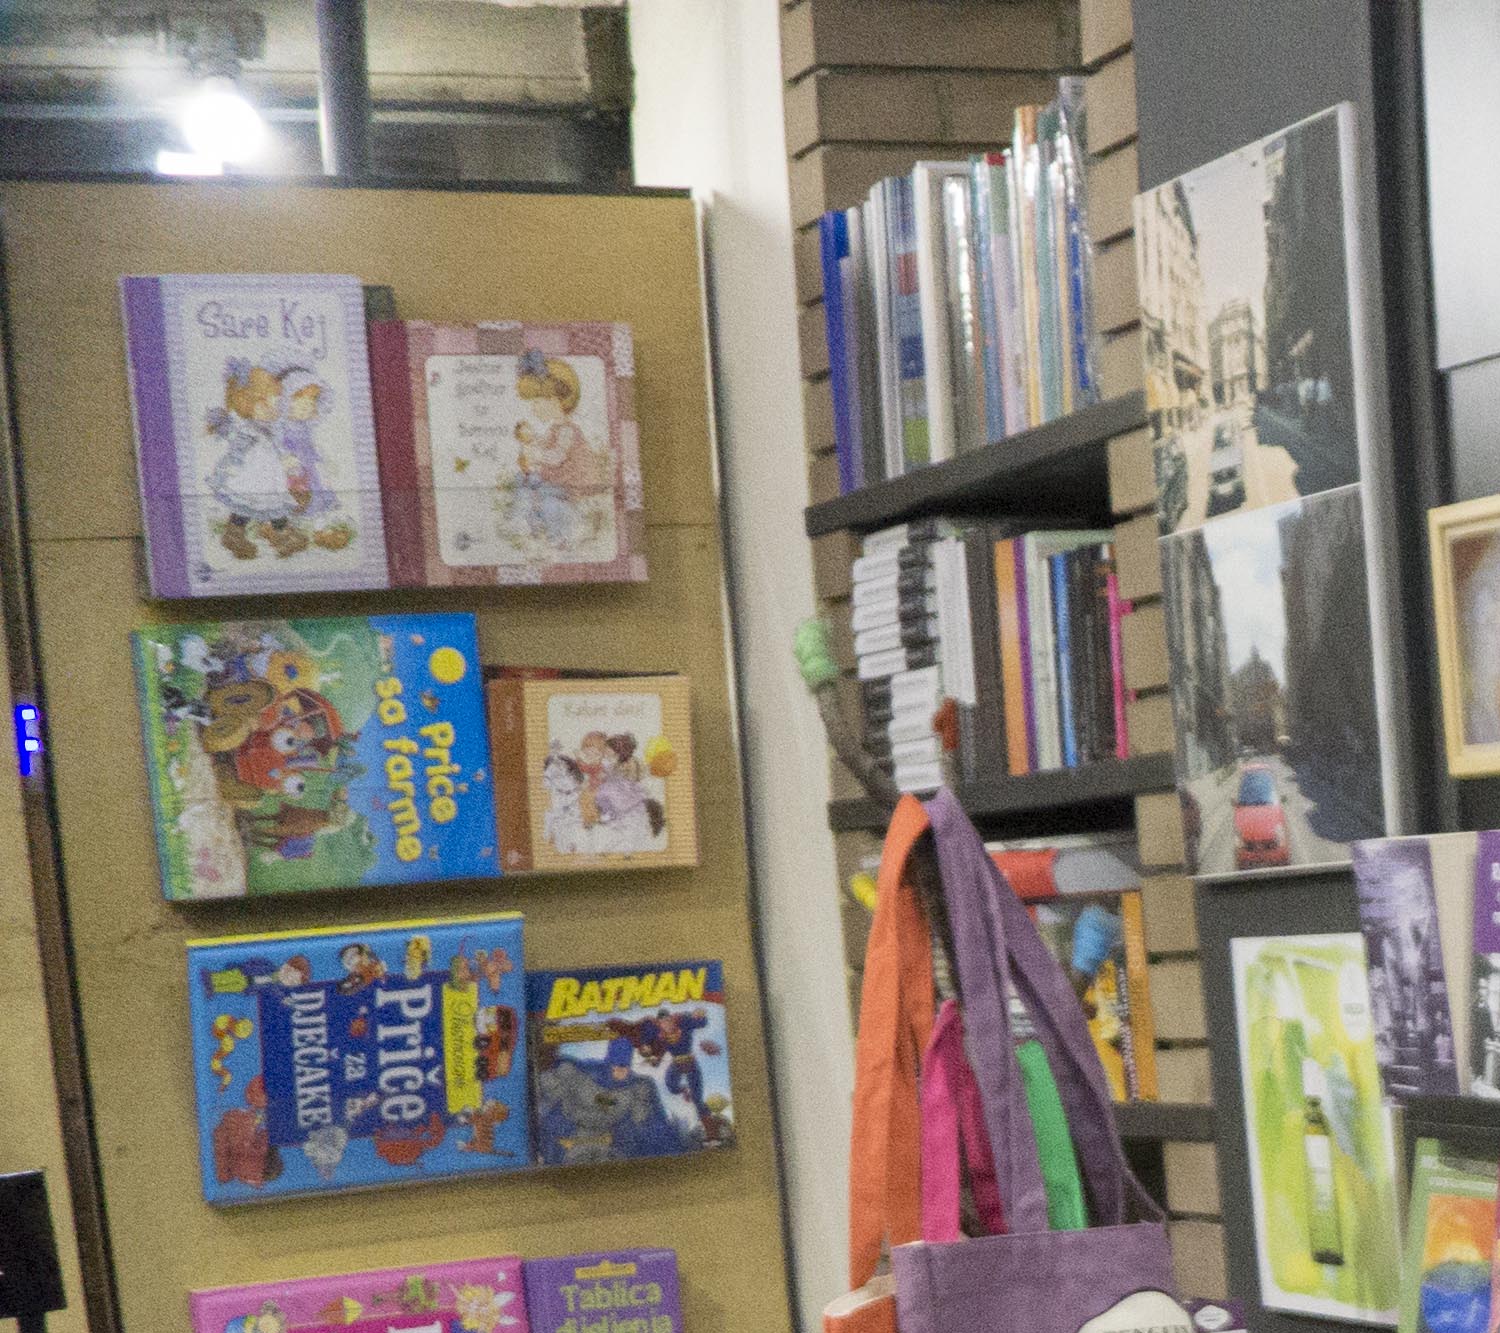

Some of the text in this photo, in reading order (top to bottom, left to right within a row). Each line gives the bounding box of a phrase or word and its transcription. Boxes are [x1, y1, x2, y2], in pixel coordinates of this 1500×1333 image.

[374, 678, 421, 861] sa farme
[546, 967, 707, 1020] BATMAN
[290, 989, 338, 1128] DJEČAKE
[345, 1053, 368, 1081] za
[375, 983, 442, 1122] Priče
[559, 1280, 662, 1313] Tablica
